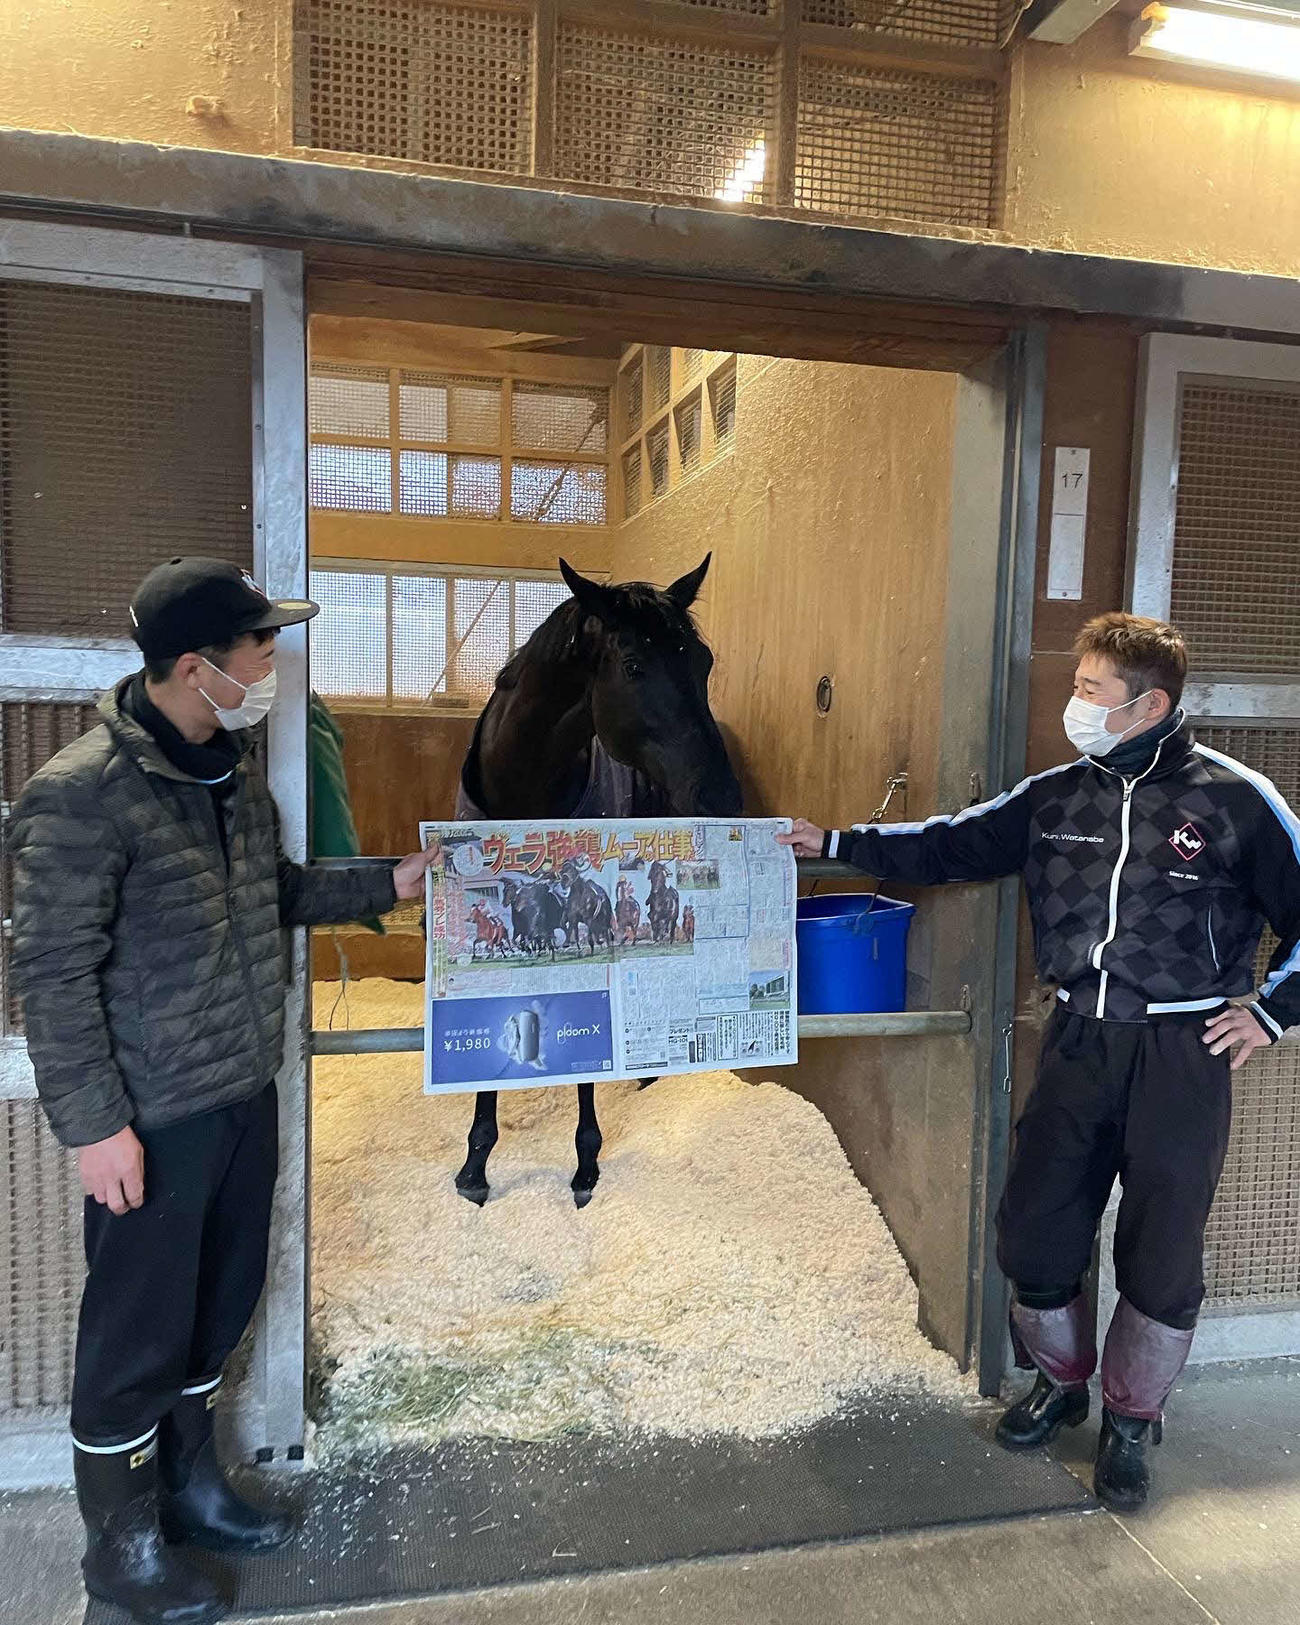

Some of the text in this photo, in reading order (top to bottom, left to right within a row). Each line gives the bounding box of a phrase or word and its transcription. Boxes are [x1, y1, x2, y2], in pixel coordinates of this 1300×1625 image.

[1061, 473, 1083, 488] 17
[557, 1022, 600, 1045] ploom X
[444, 1037, 491, 1052] ¥1,980
